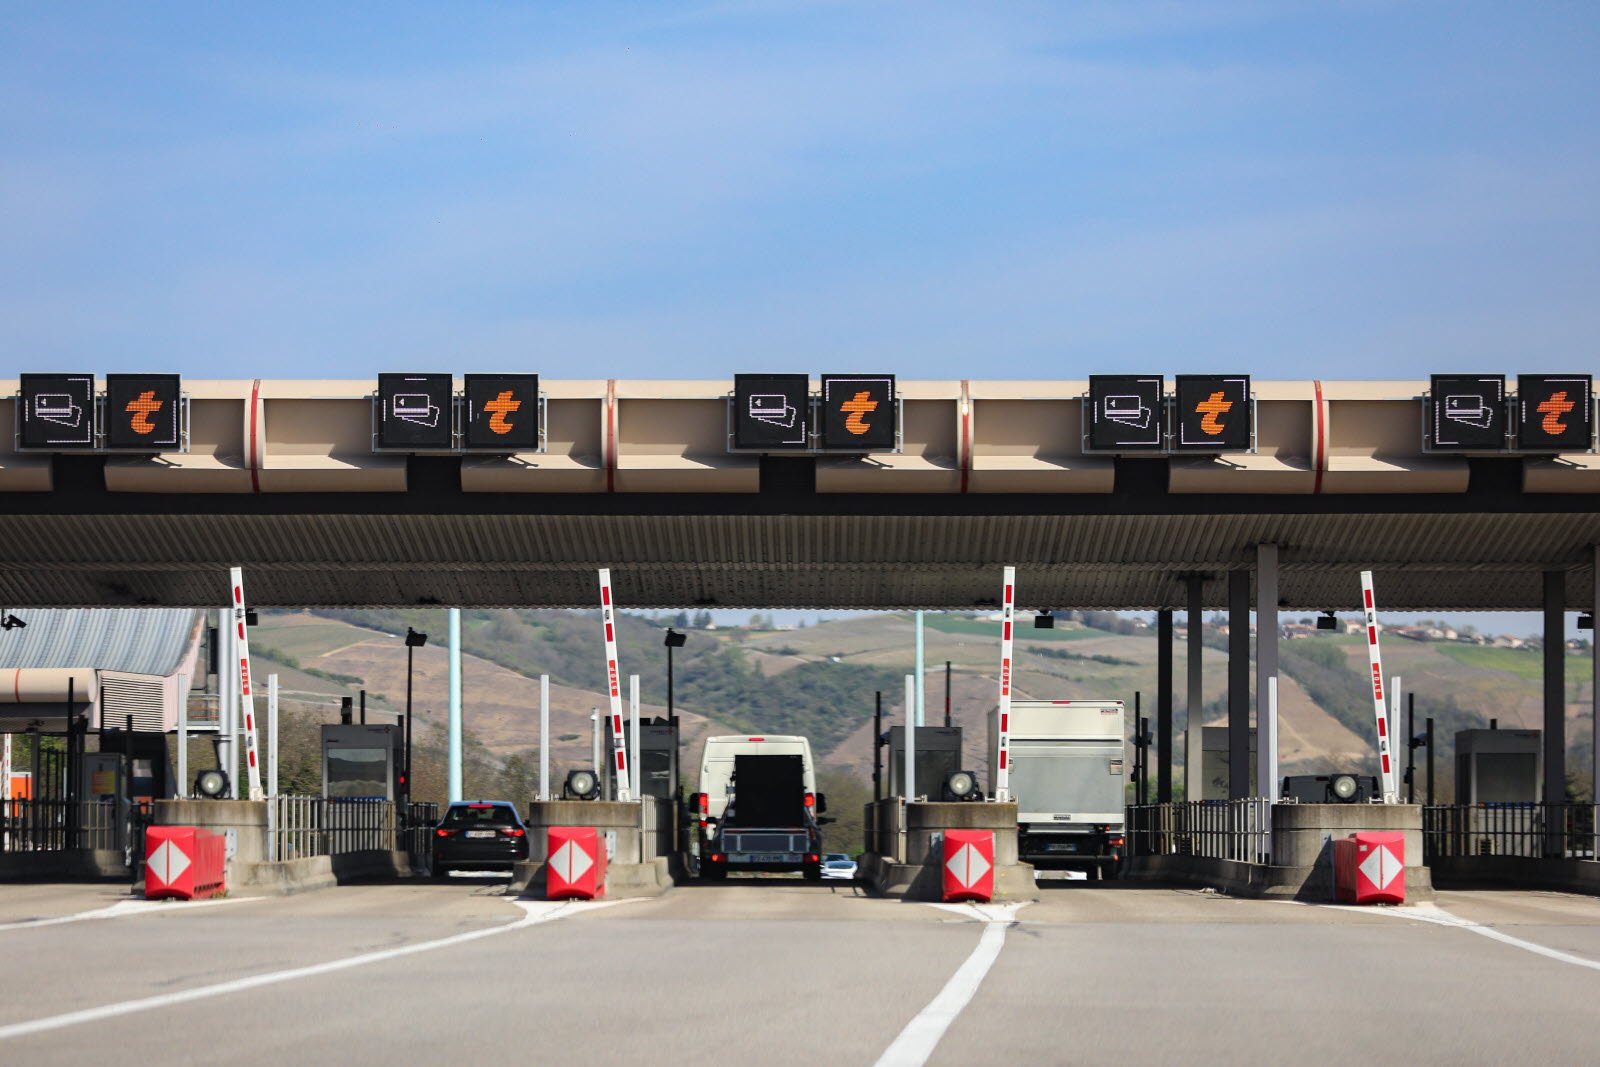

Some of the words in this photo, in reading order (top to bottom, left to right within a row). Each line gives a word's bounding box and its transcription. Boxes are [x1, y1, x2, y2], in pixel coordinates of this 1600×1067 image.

[125, 390, 163, 435] t
[483, 390, 522, 435] t
[840, 391, 879, 435] t
[1195, 391, 1233, 436] t
[1535, 391, 1575, 435] t
[1002, 665, 1010, 688] STOP
[1373, 670, 1382, 693] STOP
